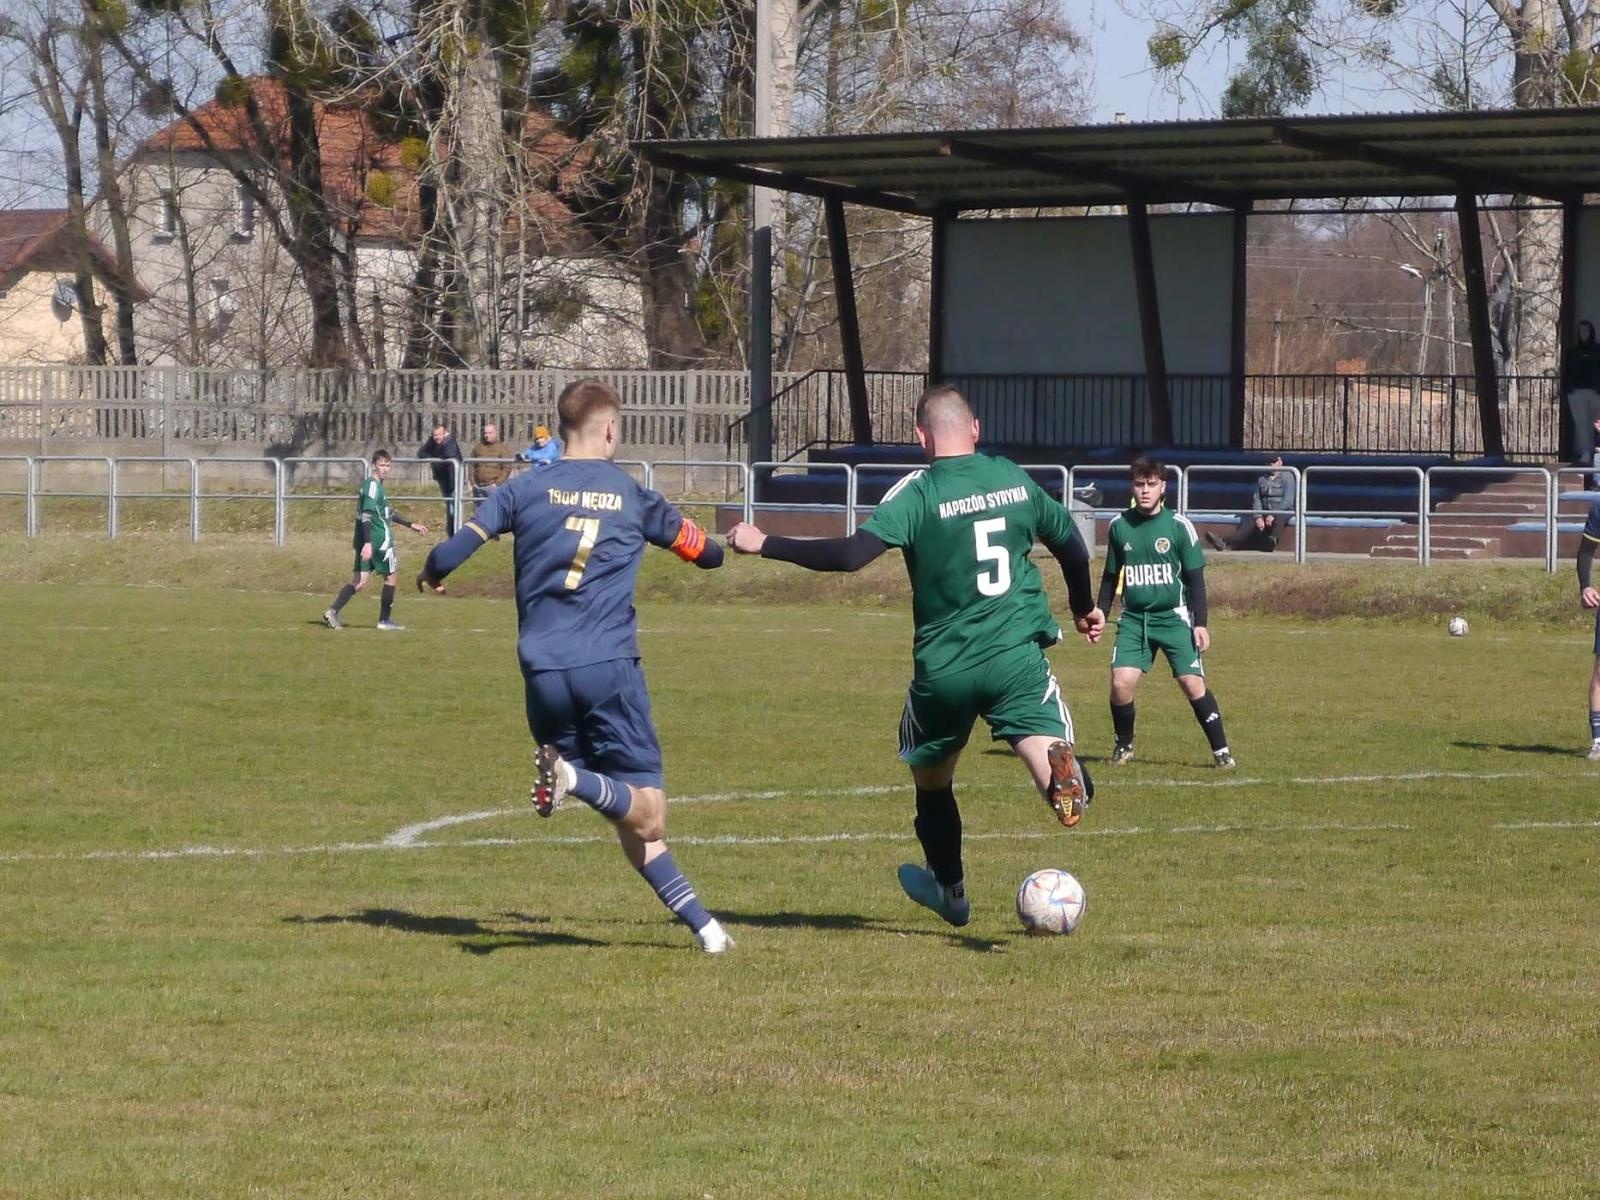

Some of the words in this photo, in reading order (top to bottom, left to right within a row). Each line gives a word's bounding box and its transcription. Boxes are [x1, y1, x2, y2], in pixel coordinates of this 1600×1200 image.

[548, 488, 579, 505] 1908
[939, 494, 986, 519] NAPRZÓD
[986, 486, 1029, 508] SYRYNIA
[565, 517, 599, 590] 7
[974, 517, 1011, 597] 5
[1125, 563, 1174, 587] BUREK
